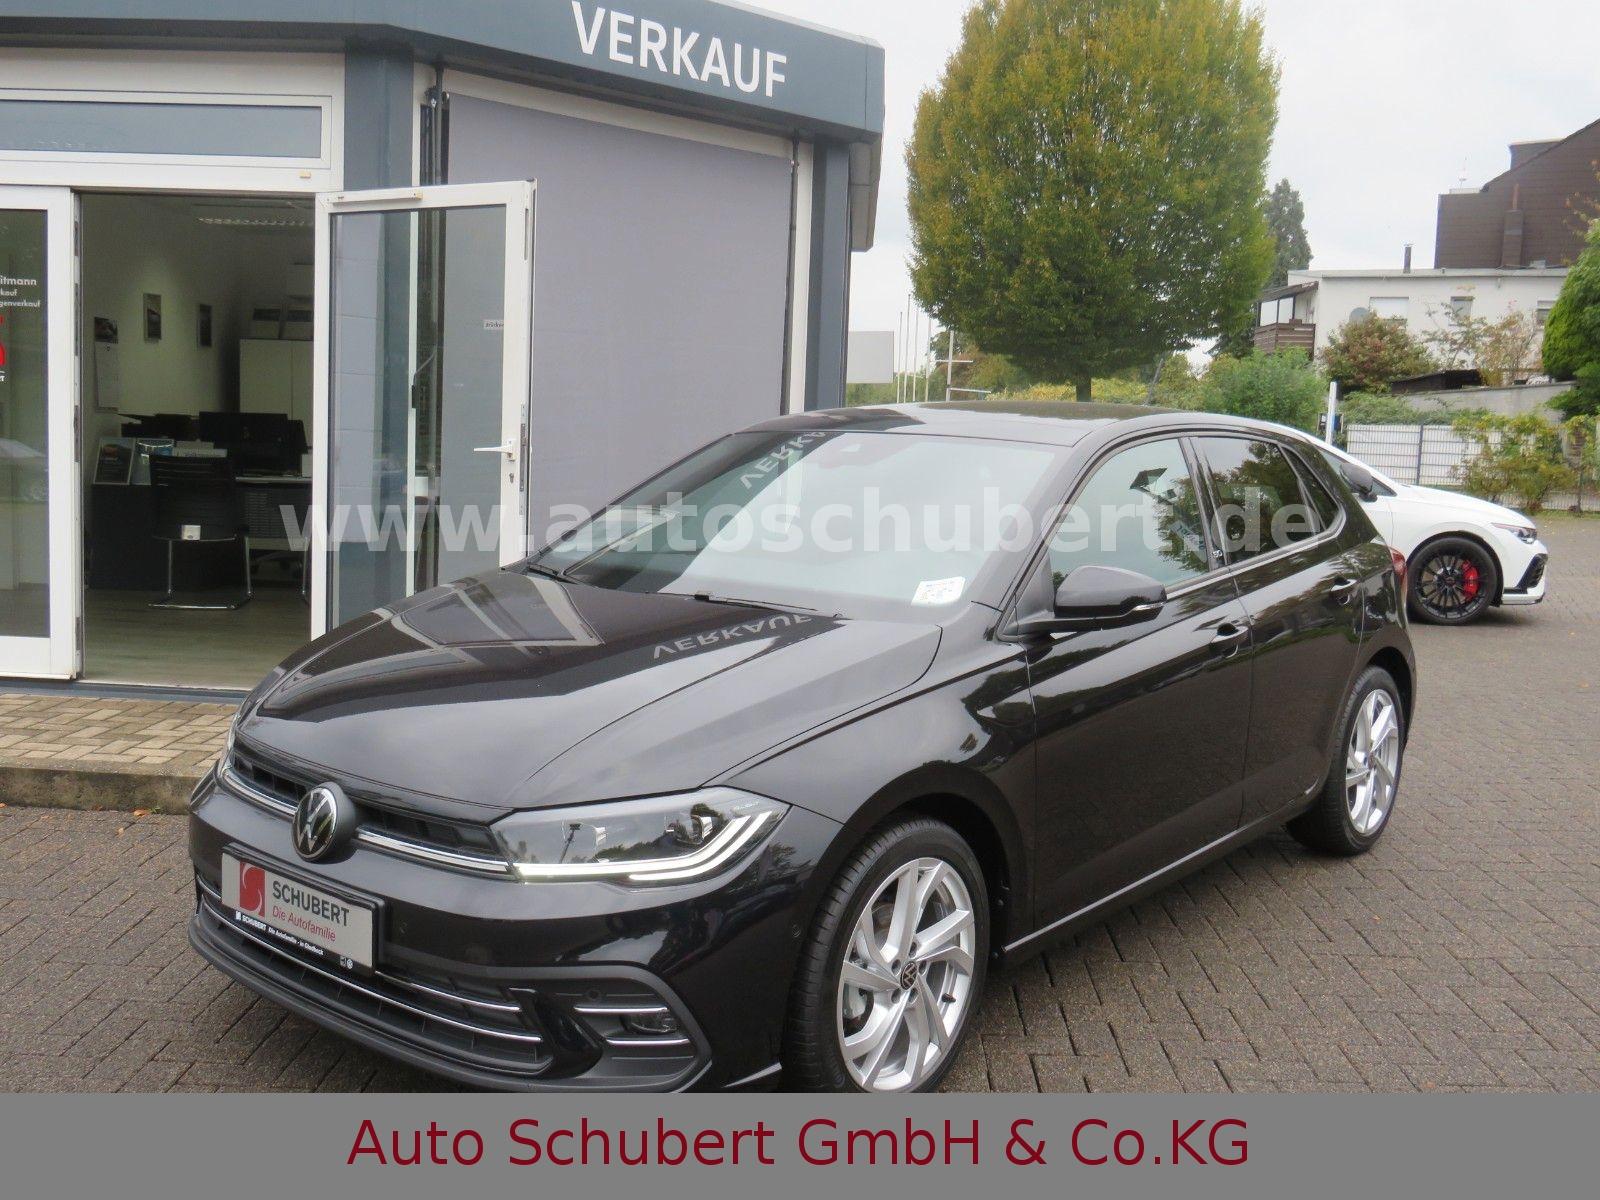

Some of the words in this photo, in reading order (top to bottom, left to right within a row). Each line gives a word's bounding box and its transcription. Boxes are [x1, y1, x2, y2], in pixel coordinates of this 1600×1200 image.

[571, 1, 787, 98] VERKAUF
[0, 275, 37, 286] itmann
[272, 880, 350, 927] SCHUBERT
[242, 914, 267, 931] SCHUBERT
[272, 905, 286, 921] Die
[288, 912, 337, 942] Autofamilie
